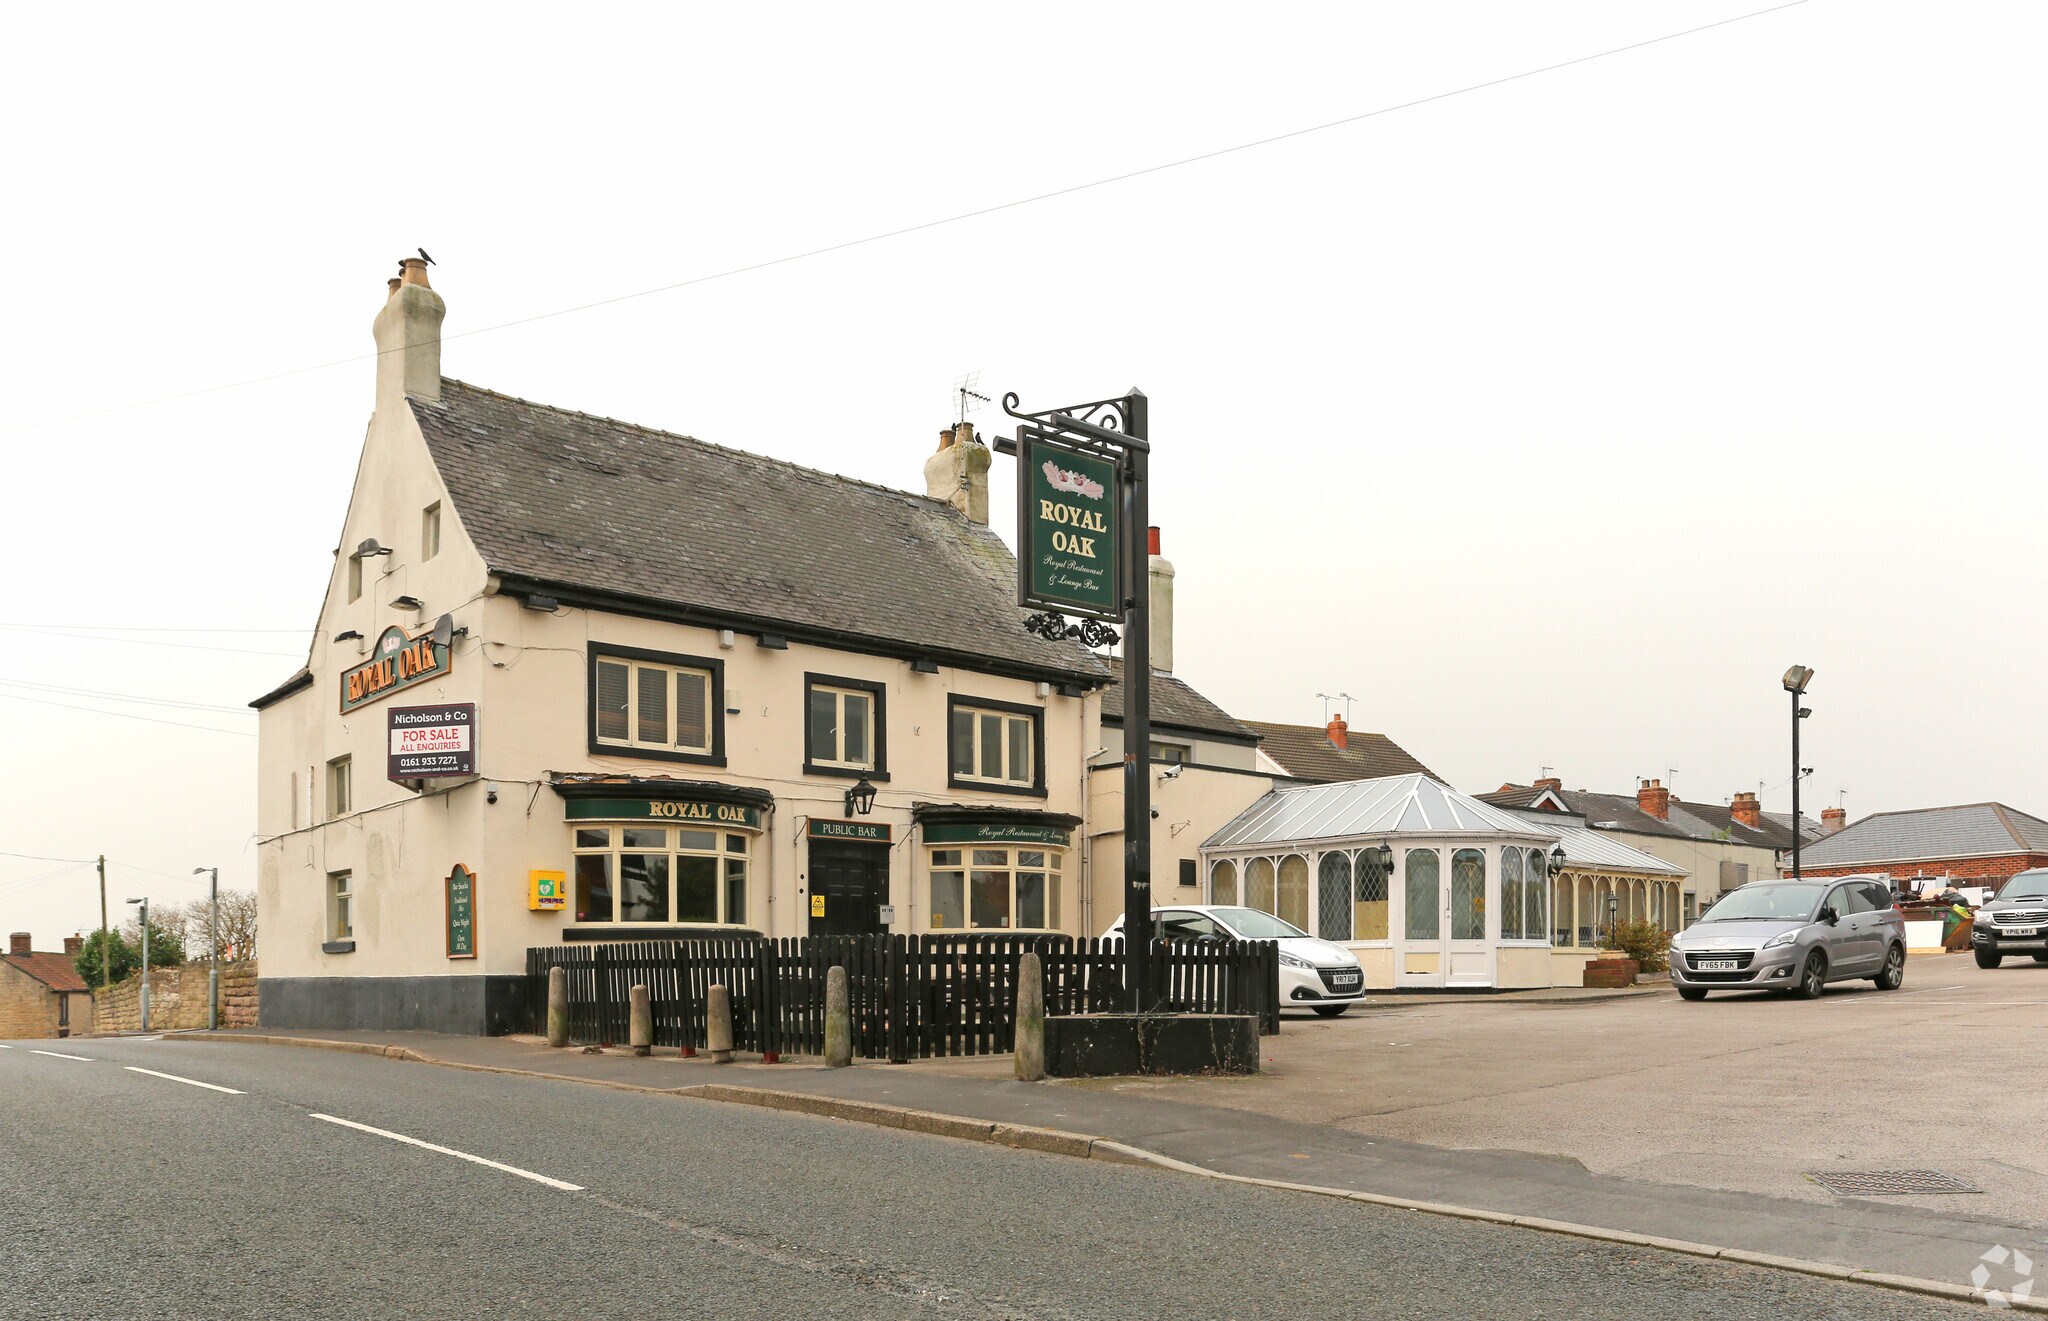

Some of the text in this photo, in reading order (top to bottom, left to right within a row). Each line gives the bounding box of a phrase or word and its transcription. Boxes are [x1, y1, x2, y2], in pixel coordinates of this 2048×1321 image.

[1040, 499, 1107, 533] ROYAL
[1052, 531, 1096, 558] OAK
[1043, 554, 1104, 576] Royal Restaurant
[1048, 574, 1100, 591] & Lounge Bar
[348, 640, 437, 703] ROYAL OAK
[395, 711, 467, 724] Nicholson & Co
[403, 728, 459, 742] FOR SALE
[400, 741, 461, 752] ALL ENQUIRIES
[400, 756, 458, 767] 0161 933 7271
[650, 802, 746, 822] ROYAL OAK
[822, 823, 877, 838] PUBLIC BAR
[978, 826, 1006, 839] Royal
[1006, 827, 1043, 837] Restaurant
[1043, 831, 1049, 840] &
